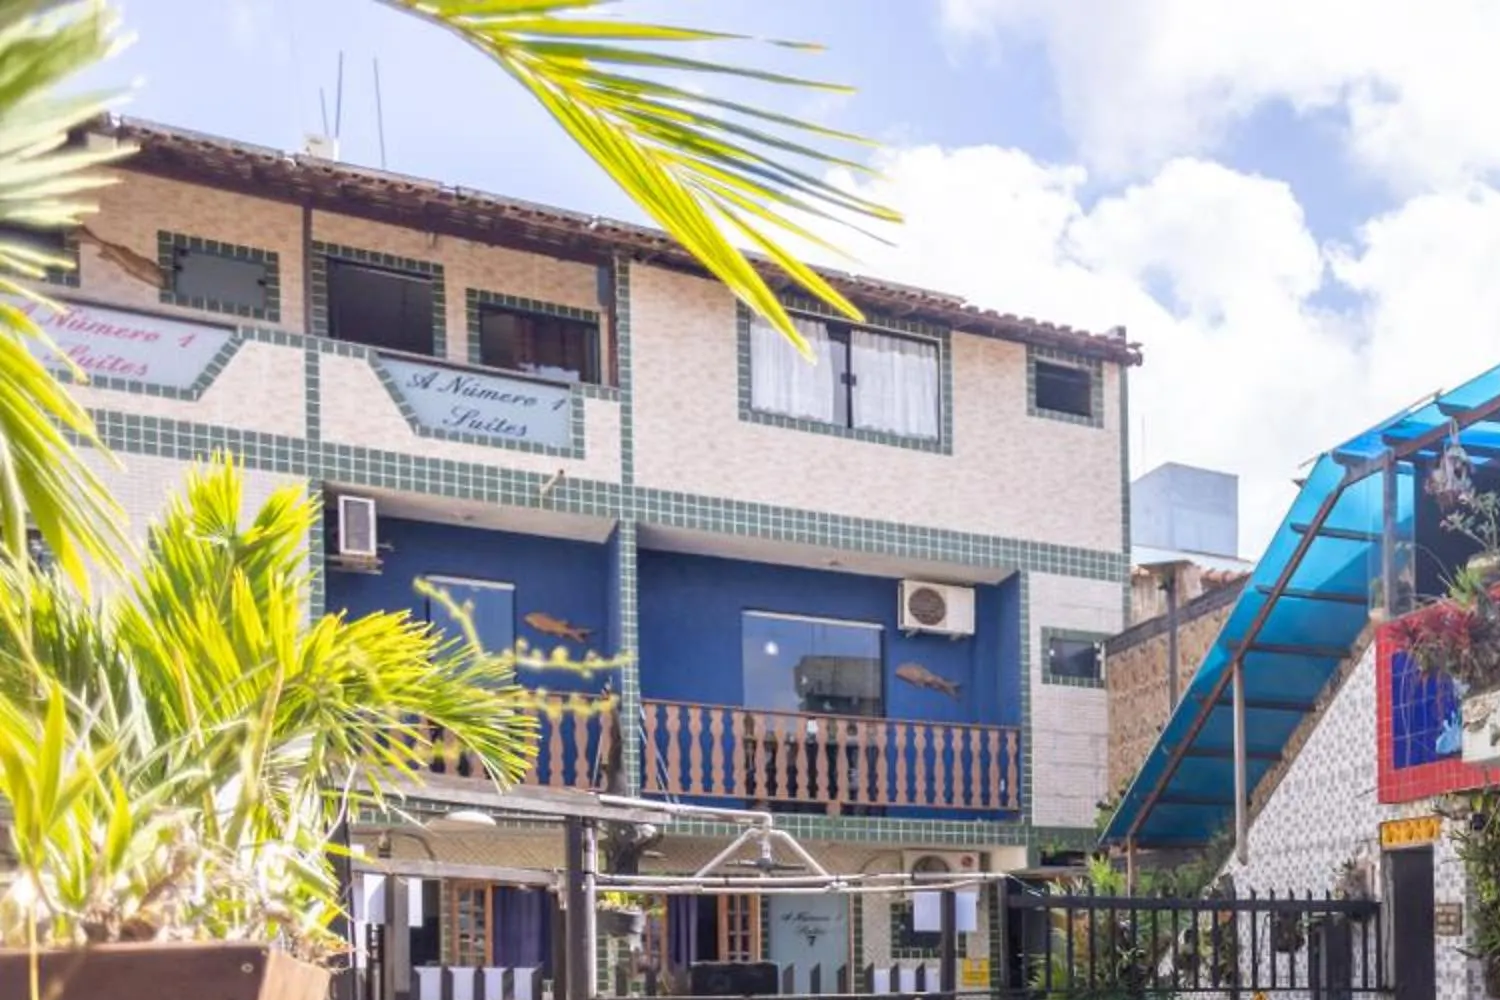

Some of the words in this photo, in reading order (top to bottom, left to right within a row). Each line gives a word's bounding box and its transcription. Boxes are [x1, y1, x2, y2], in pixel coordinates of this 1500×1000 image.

[178, 332, 197, 348] 1
[406, 371, 439, 389] A
[437, 374, 539, 407] Número
[551, 398, 567, 412] 1
